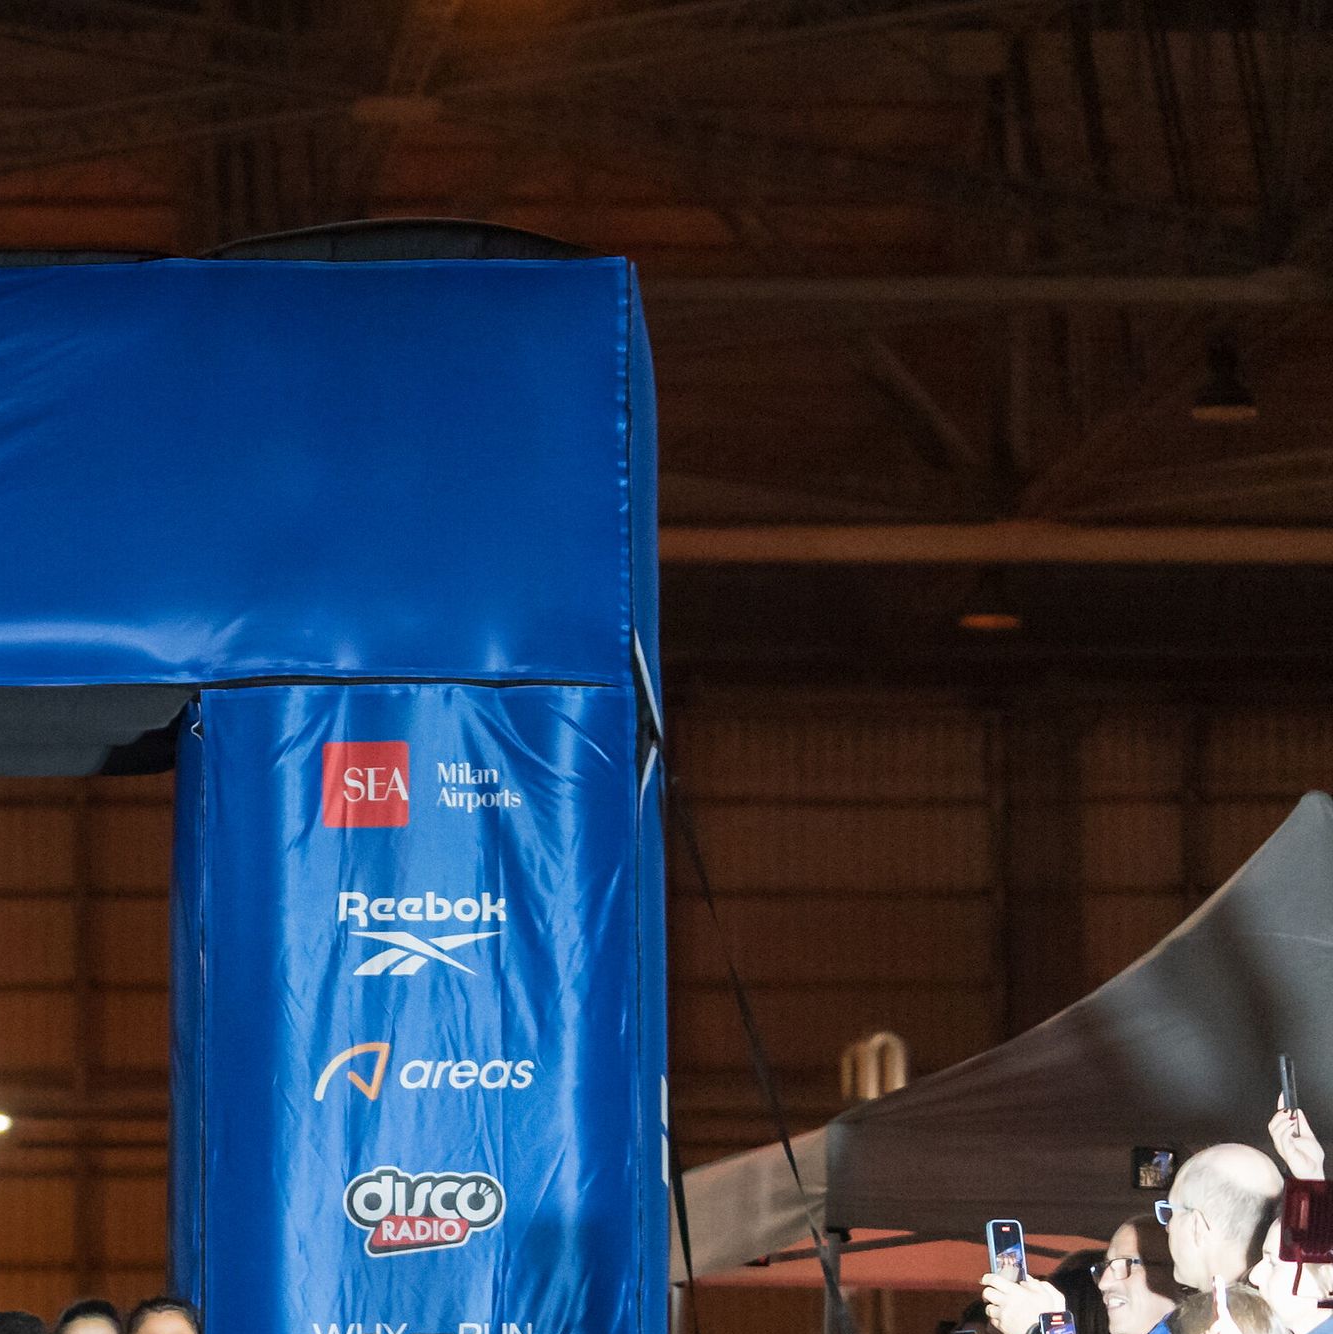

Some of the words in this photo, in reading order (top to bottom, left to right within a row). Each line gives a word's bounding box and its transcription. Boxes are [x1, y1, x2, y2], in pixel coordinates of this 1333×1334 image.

[343, 767, 409, 802] SEA
[437, 762, 498, 784] Milan
[436, 787, 522, 814] Airports
[338, 892, 507, 927] Reebok
[399, 1059, 535, 1090] areas
[352, 1176, 499, 1221] disco
[381, 1220, 462, 1242] RADIO
